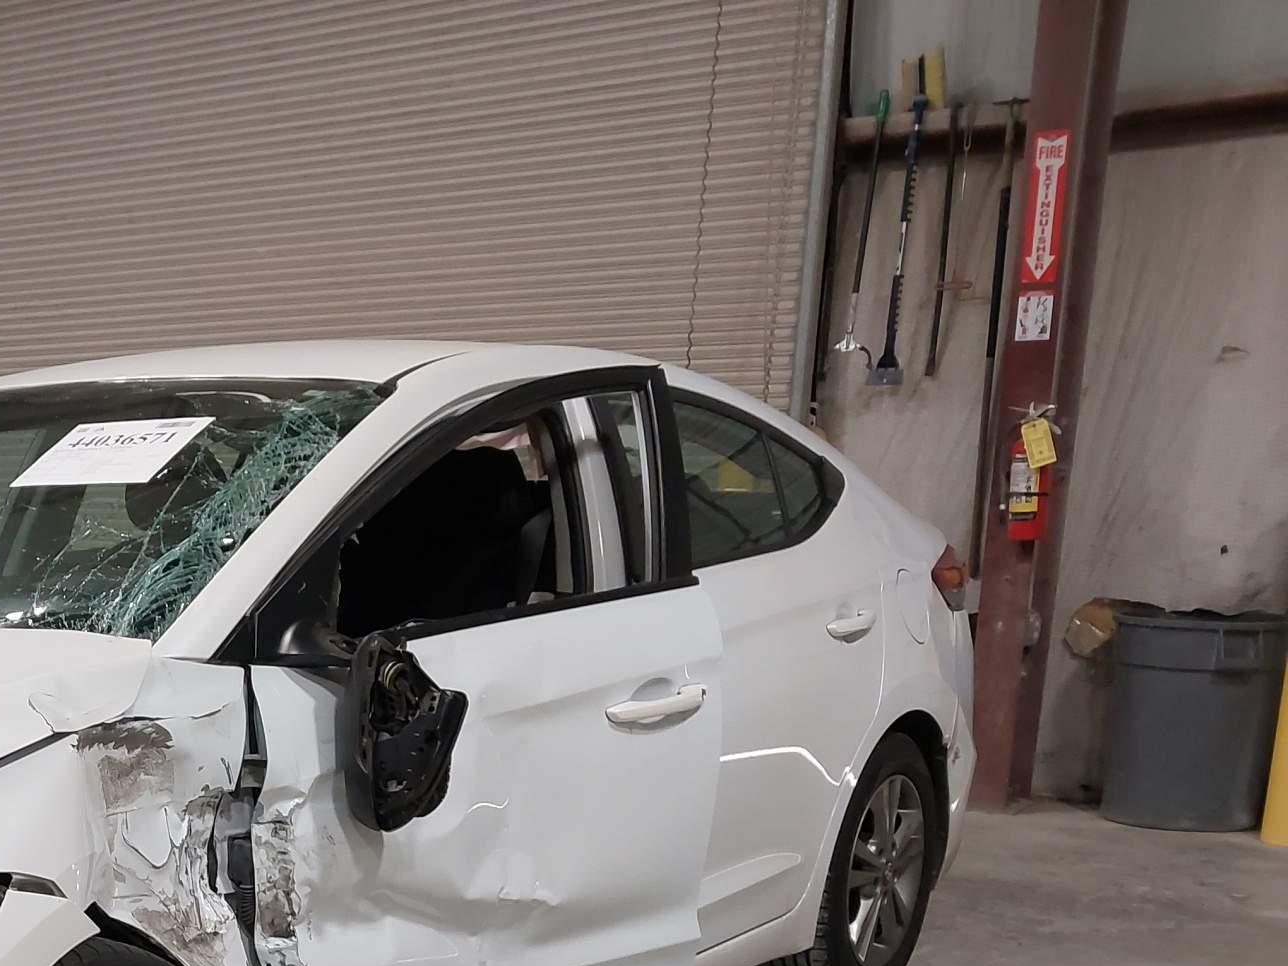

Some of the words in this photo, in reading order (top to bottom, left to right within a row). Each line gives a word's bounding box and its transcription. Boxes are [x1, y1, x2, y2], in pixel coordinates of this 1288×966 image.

[1038, 145, 1064, 160] FIRE
[1034, 164, 1055, 271] EXTINGUISHER
[68, 431, 178, 448] 44036571
